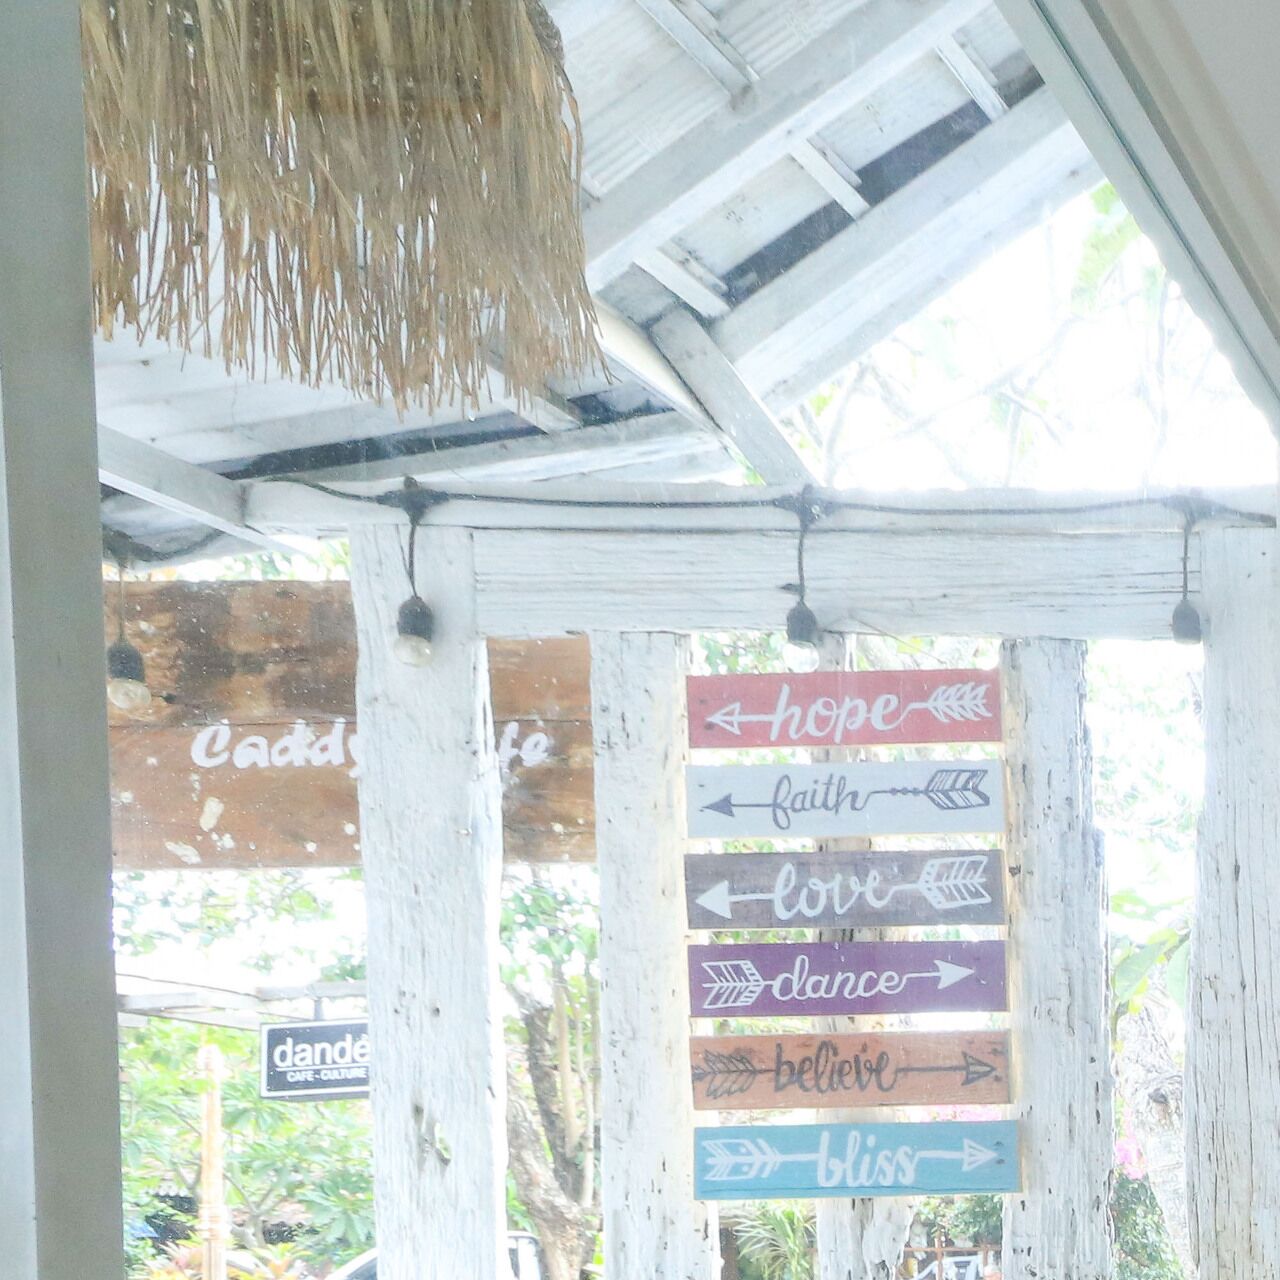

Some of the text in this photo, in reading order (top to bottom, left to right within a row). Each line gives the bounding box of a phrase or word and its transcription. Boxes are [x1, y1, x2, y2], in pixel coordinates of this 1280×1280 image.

[771, 684, 899, 744] hope
[772, 773, 868, 829] faith
[772, 862, 898, 922] love
[771, 955, 905, 1000] dance
[773, 1040, 898, 1094] believe
[816, 1131, 919, 1187] bliss
